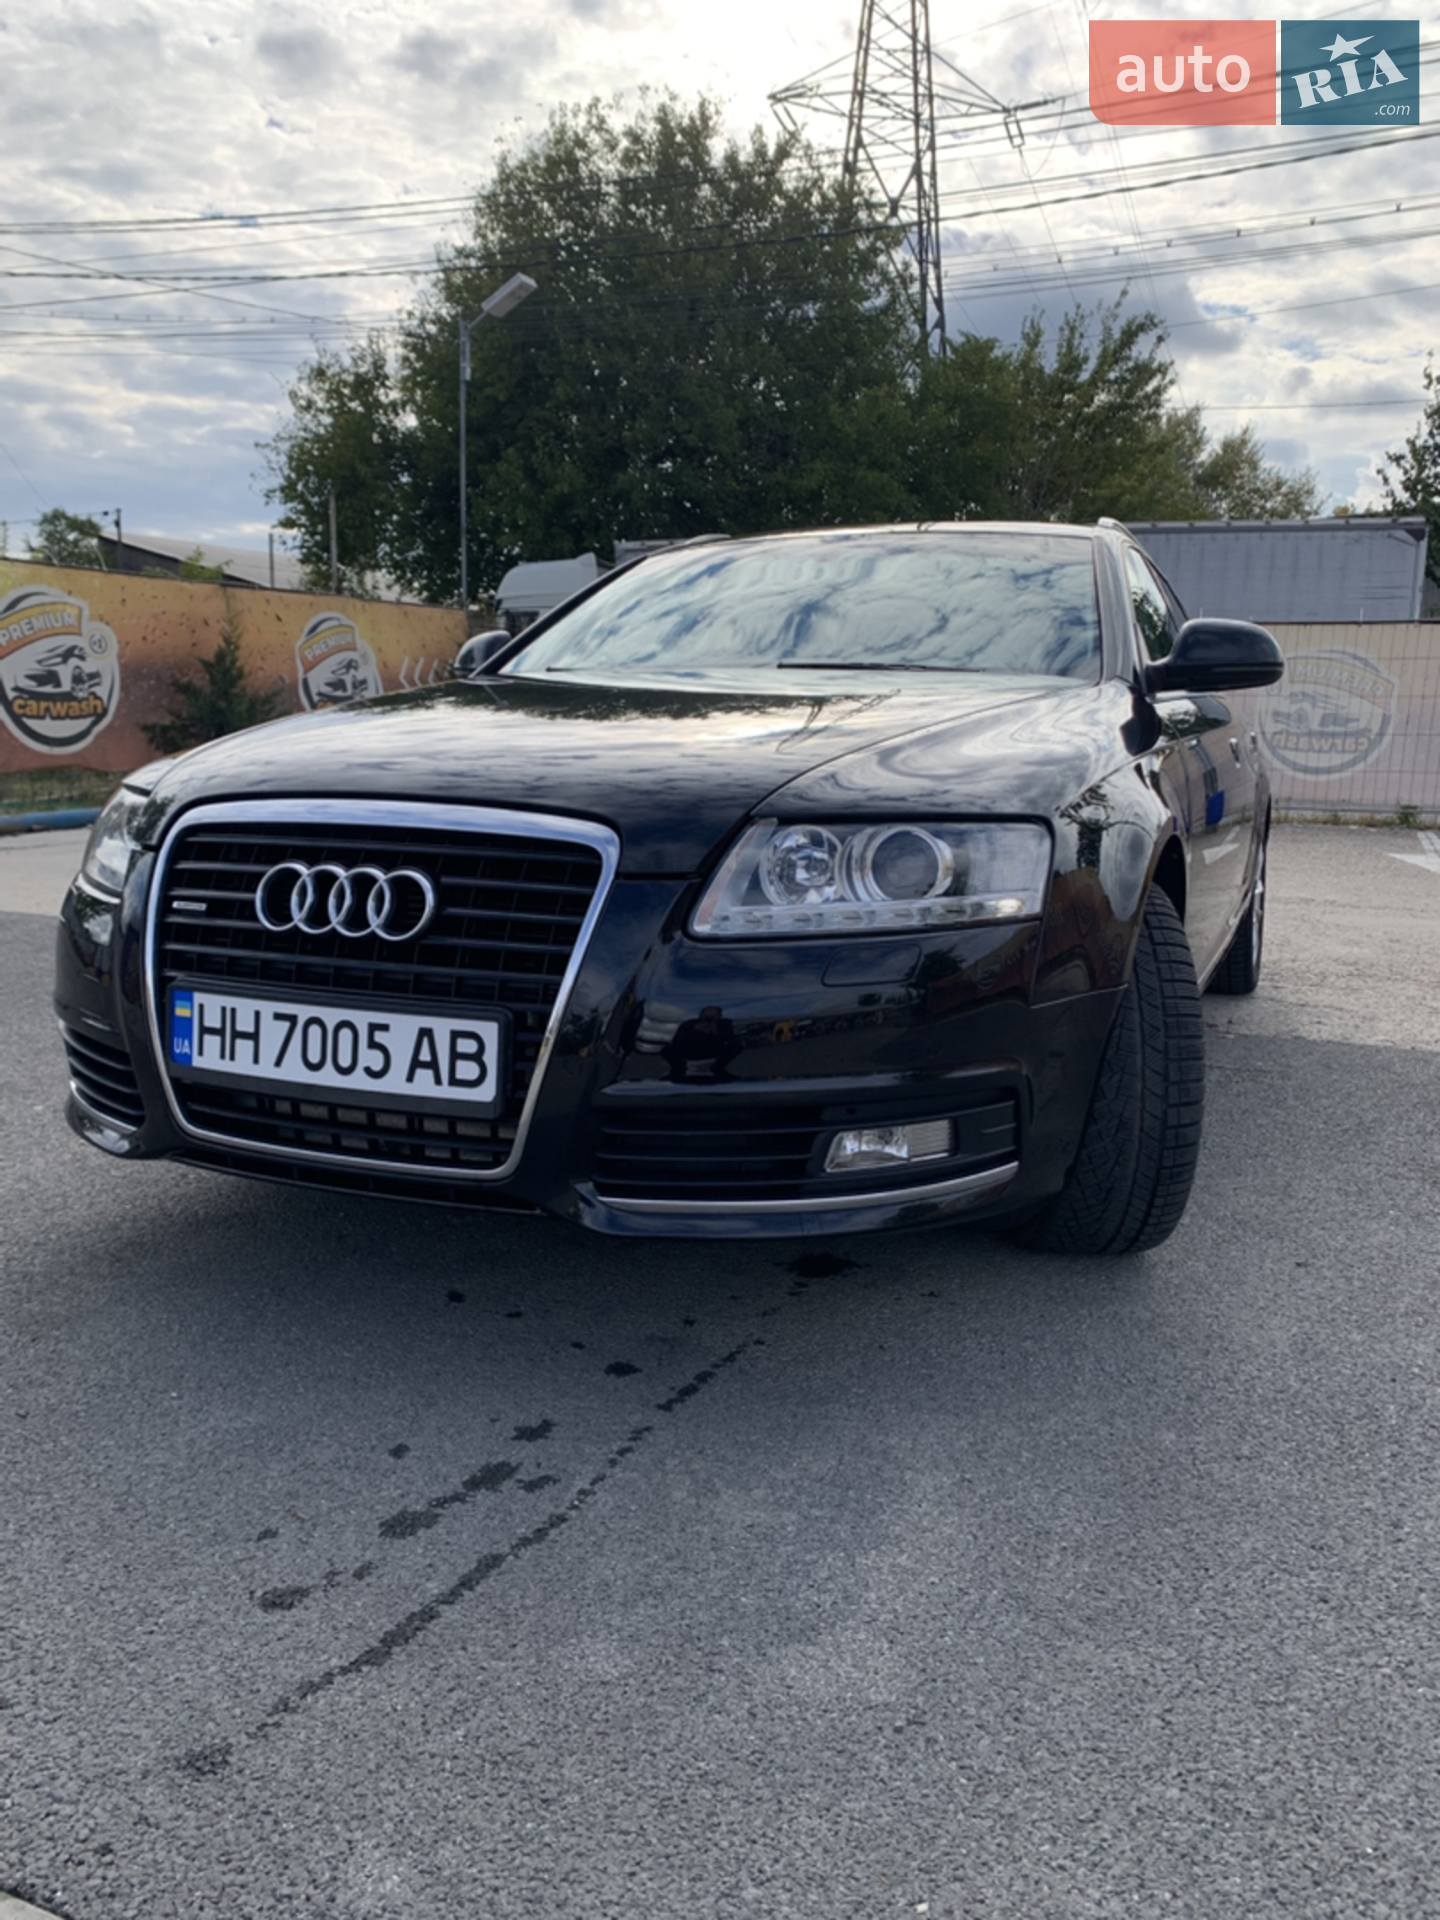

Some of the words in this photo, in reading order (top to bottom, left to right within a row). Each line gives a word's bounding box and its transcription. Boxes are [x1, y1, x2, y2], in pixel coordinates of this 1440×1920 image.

[0, 611, 76, 647] PREMIUM
[304, 632, 354, 662] PREMIUM
[12, 693, 104, 719] carwash
[173, 1037, 191, 1056] UA
[197, 1002, 261, 1065] HH
[272, 1012, 392, 1079] 7005
[405, 1026, 488, 1089] AB
